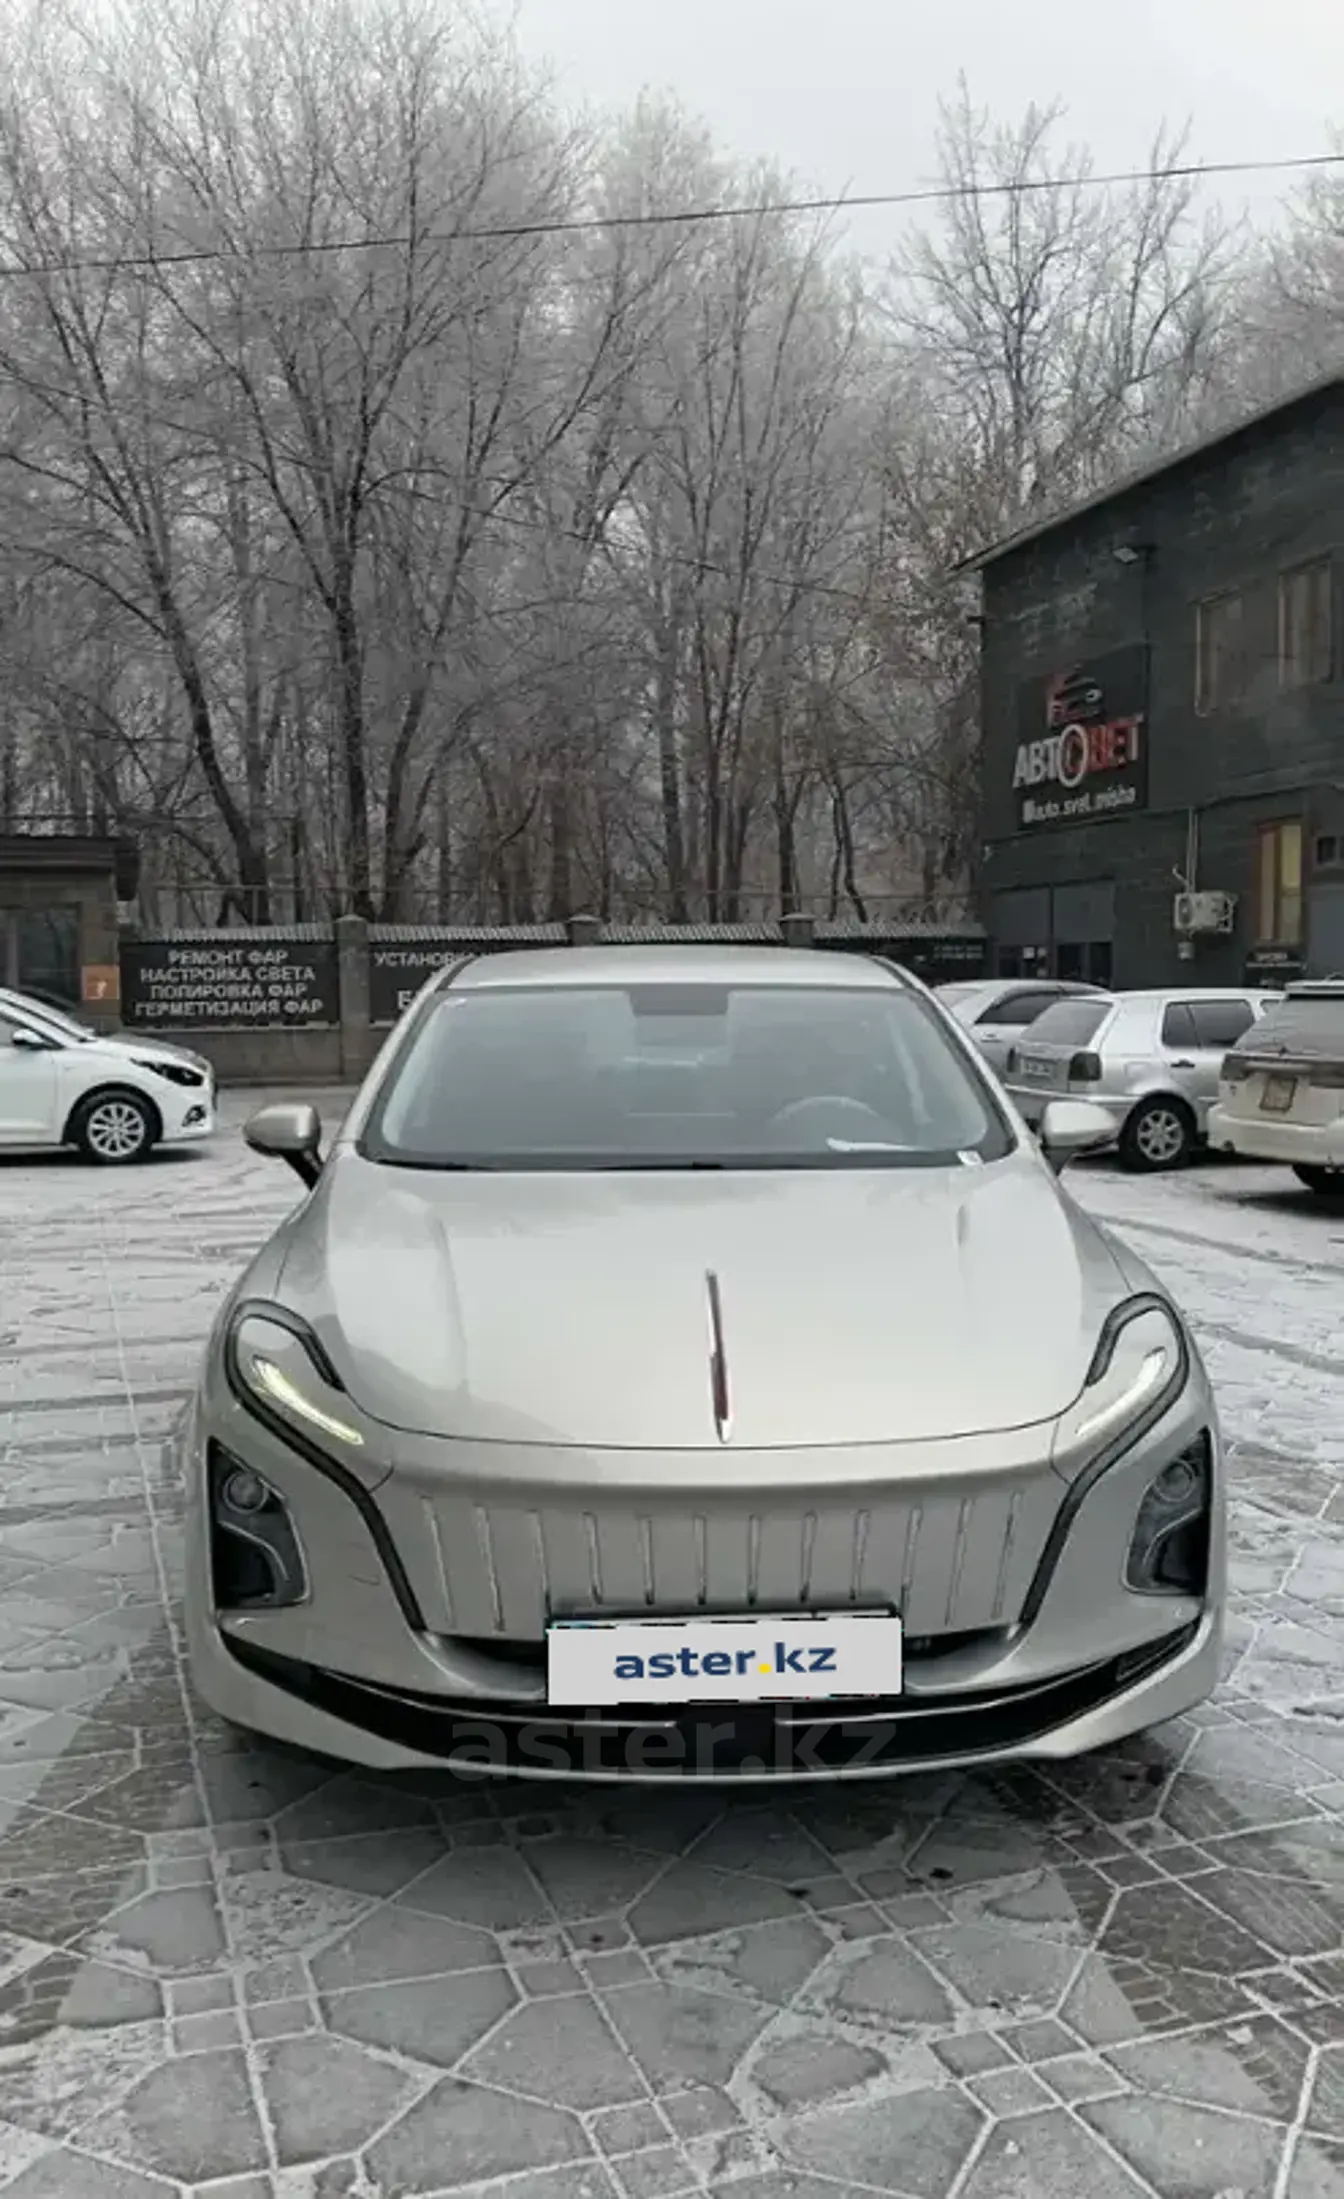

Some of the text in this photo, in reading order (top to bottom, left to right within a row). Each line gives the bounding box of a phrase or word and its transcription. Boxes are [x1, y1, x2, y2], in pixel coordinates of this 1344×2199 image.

[168, 949, 288, 965] РЕМОНТ ФАР
[255, 965, 316, 982] СВЕТА
[151, 983, 308, 1000] ПОЛИРОВКА ФАР
[134, 998, 324, 1017] ГЕРМЕТИЗАЦИЯ ФАР
